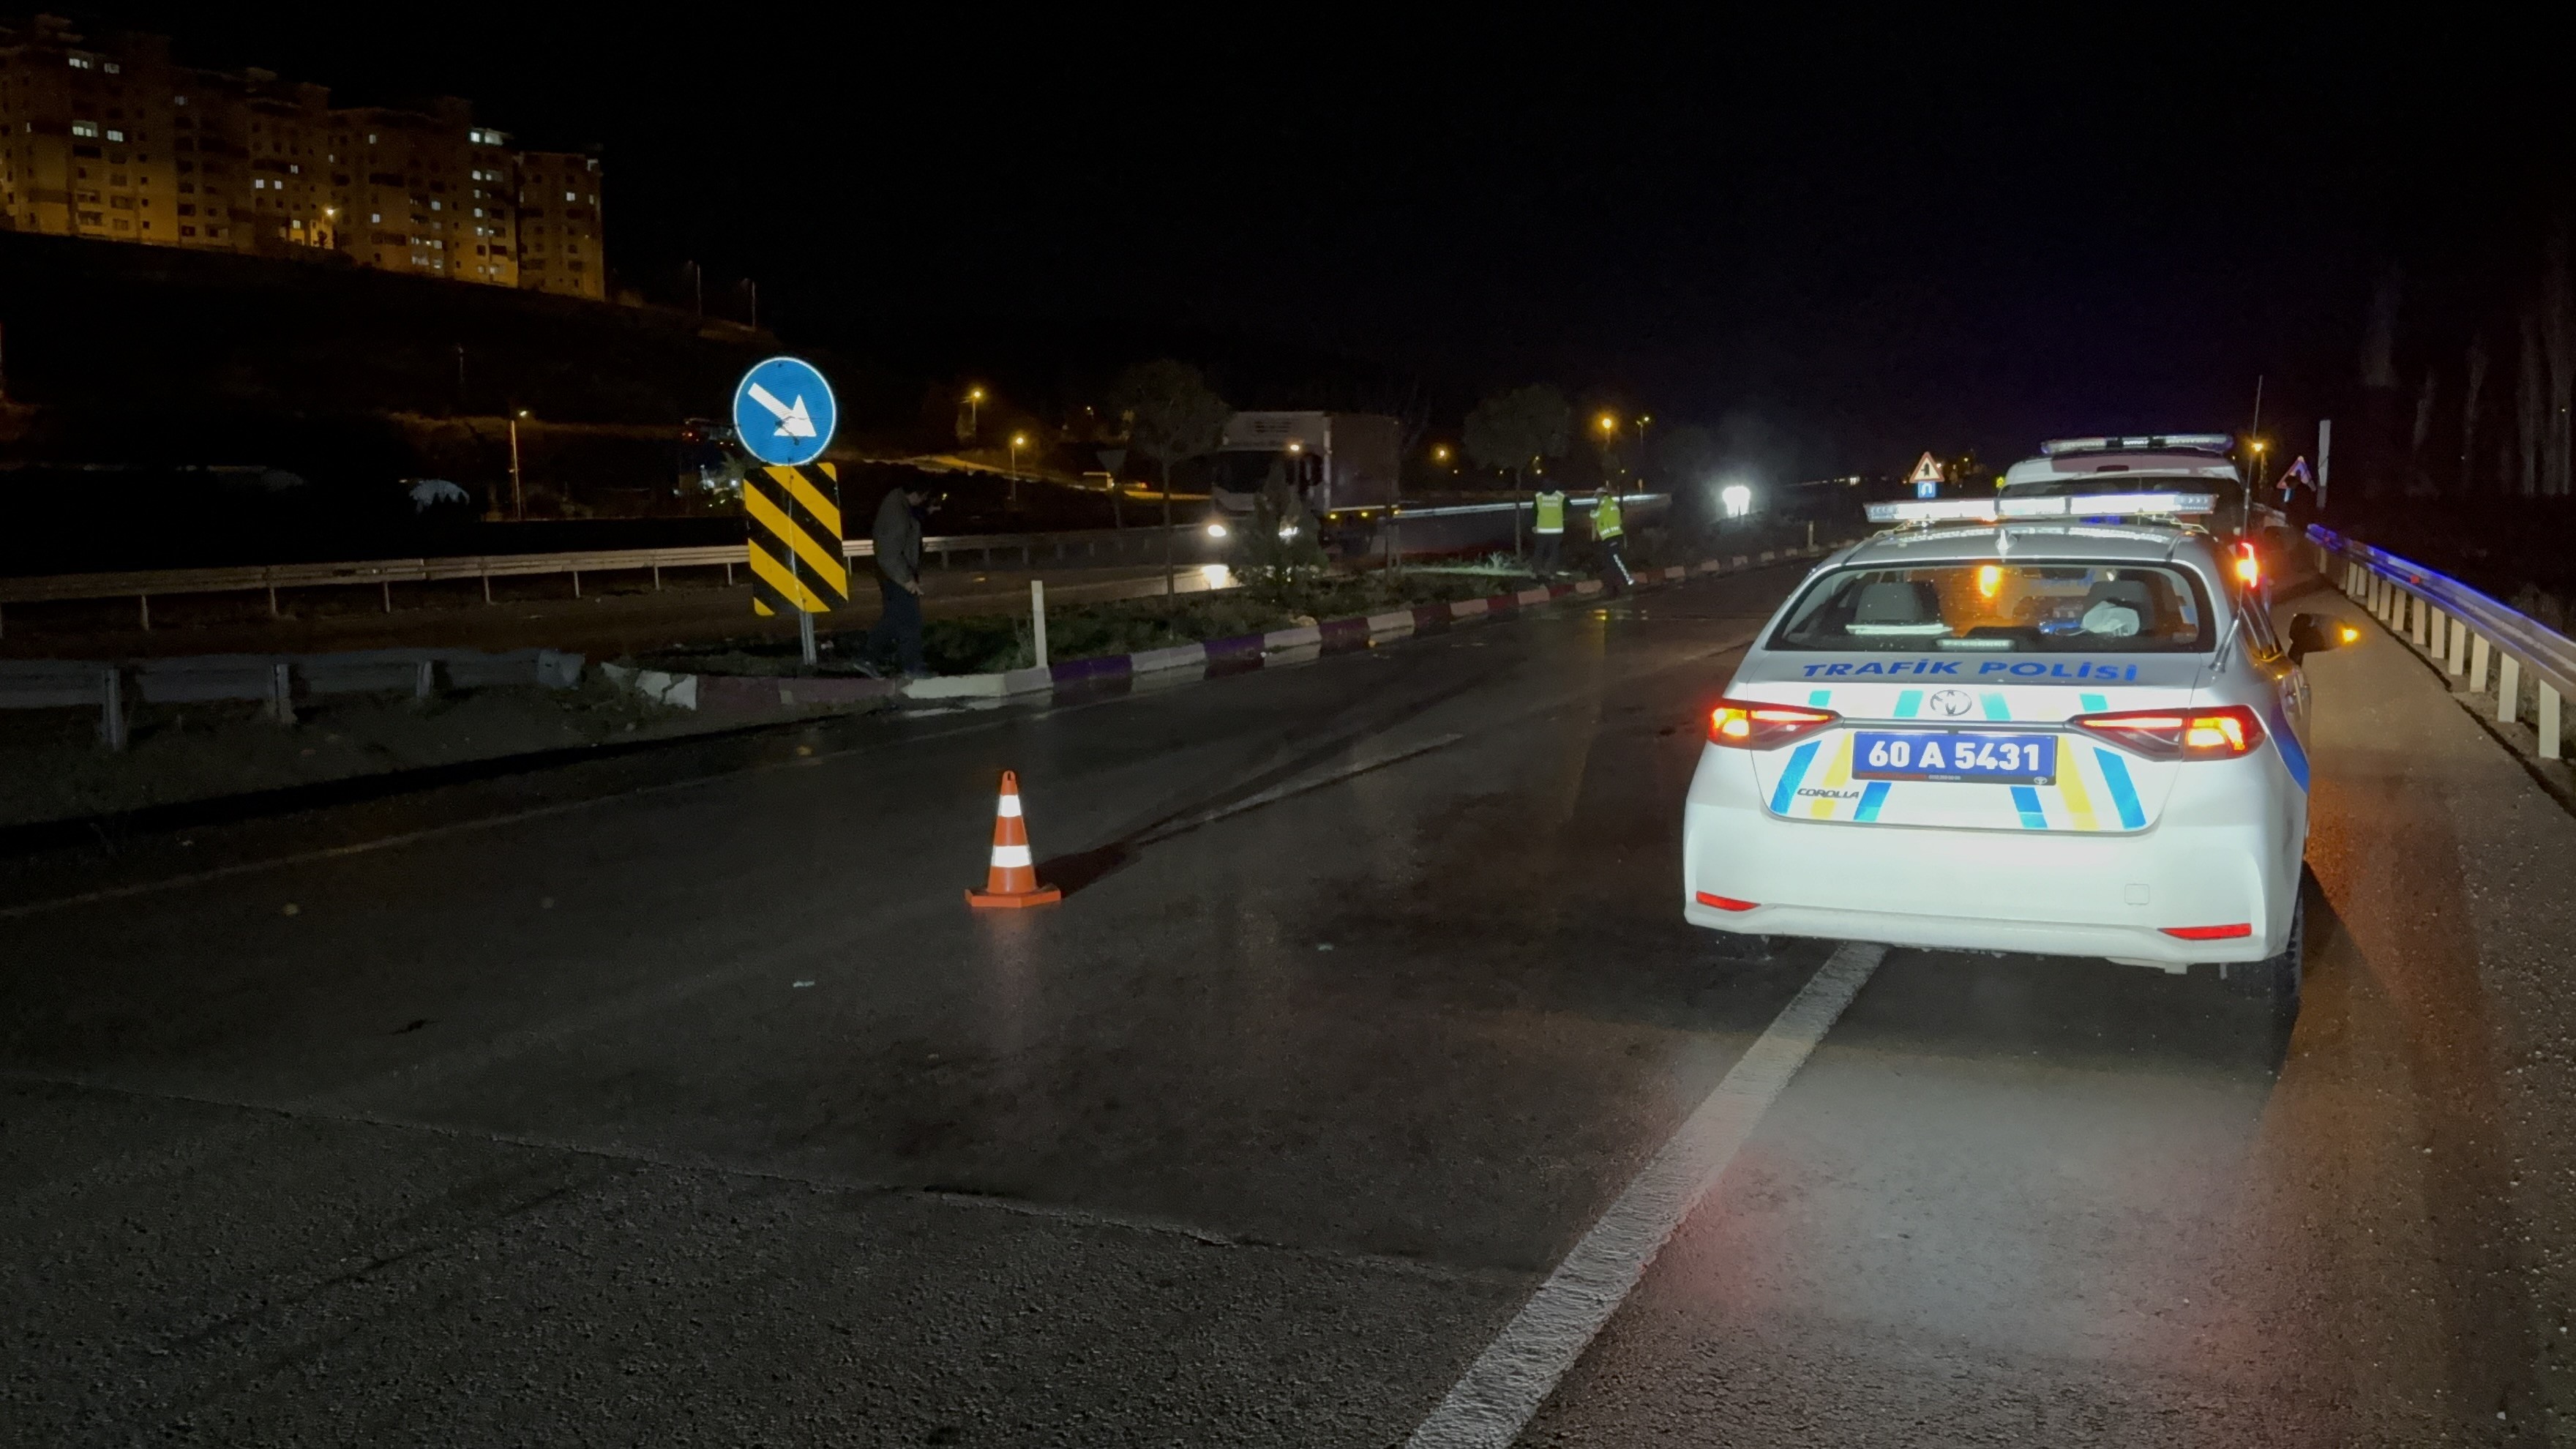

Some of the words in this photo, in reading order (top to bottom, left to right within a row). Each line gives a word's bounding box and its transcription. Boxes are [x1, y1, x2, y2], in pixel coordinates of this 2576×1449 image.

[1868, 741, 1910, 767] 60
[1918, 741, 1946, 768] A
[1955, 742, 2039, 771] 5431
[1797, 788, 1860, 799] COROLLA
